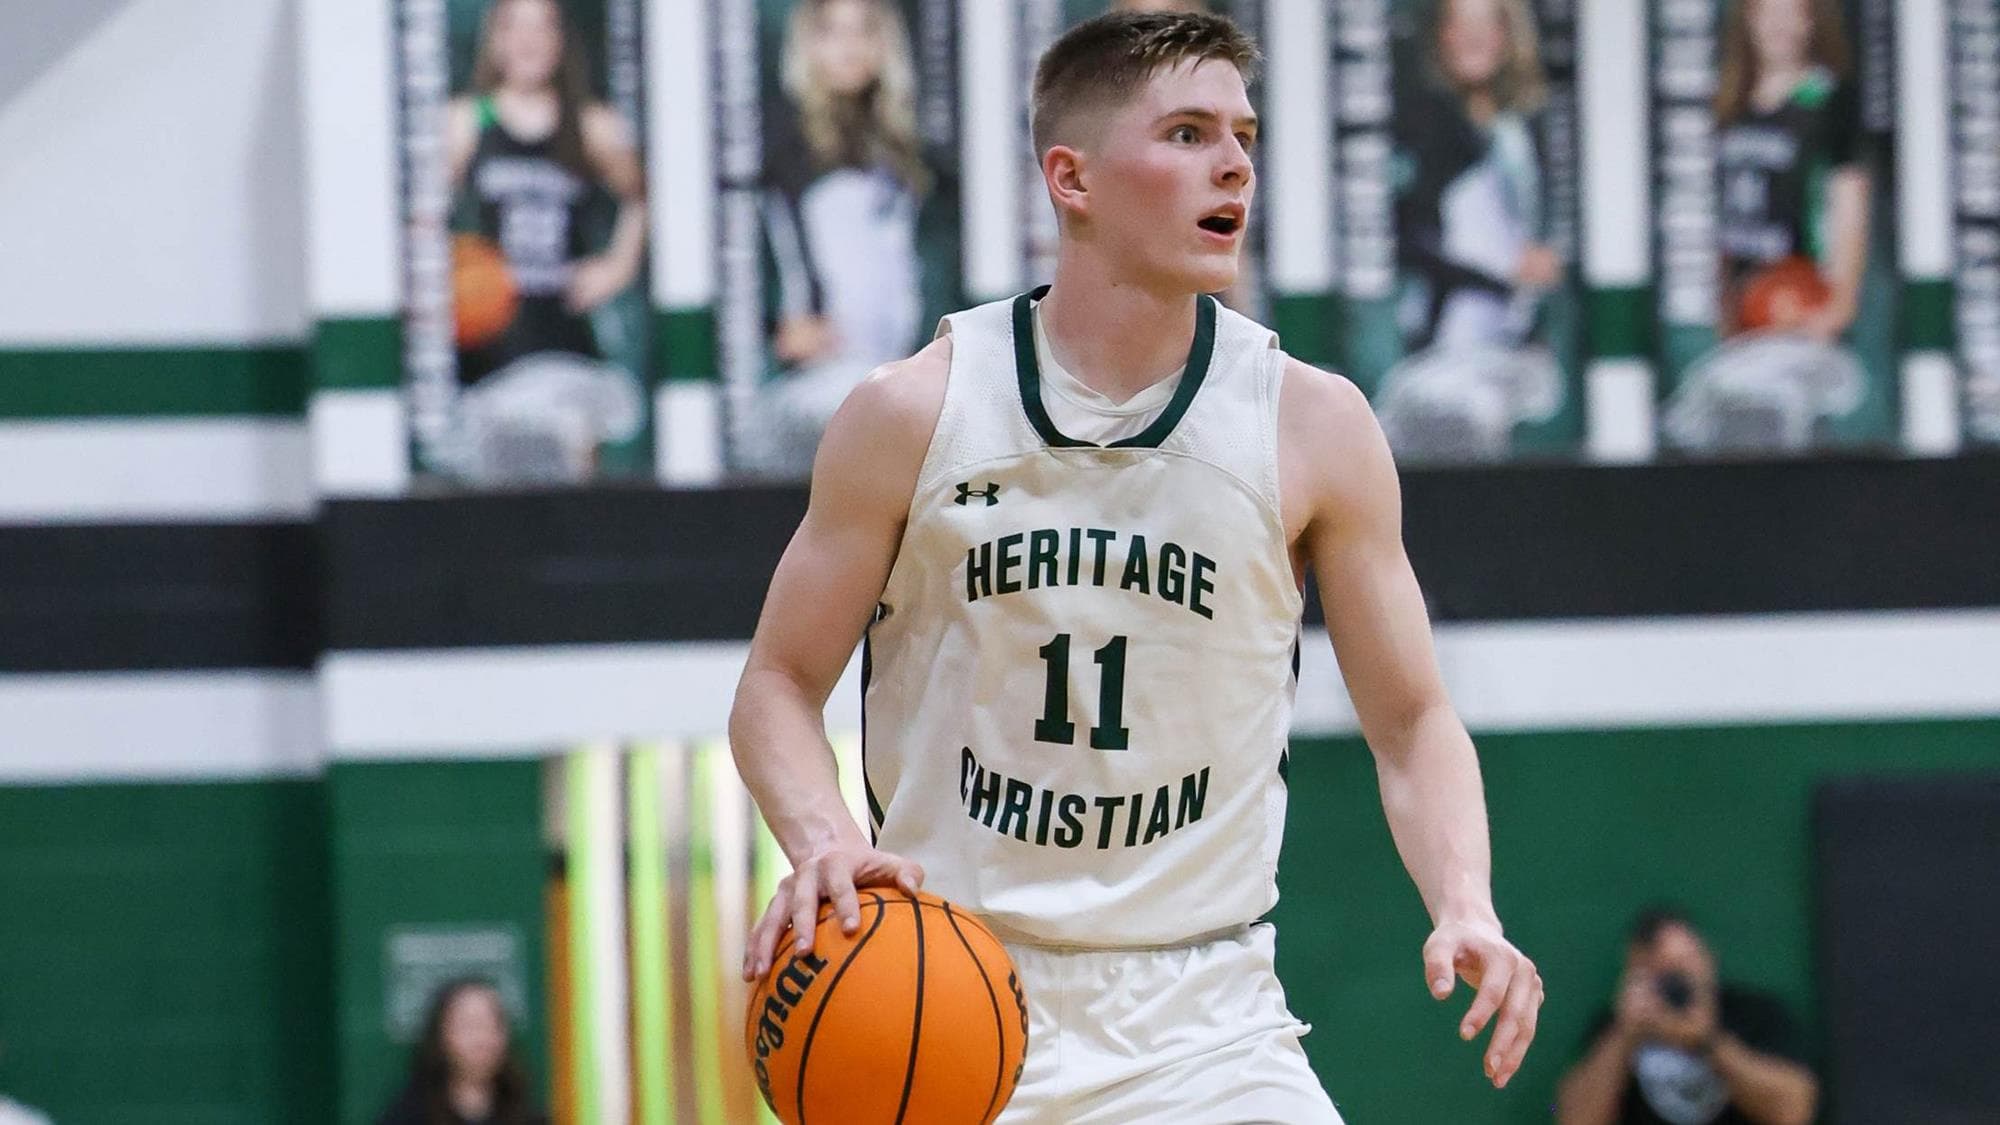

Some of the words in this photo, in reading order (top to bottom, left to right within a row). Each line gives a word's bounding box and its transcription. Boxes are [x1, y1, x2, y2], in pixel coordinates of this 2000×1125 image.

[967, 528, 1216, 620] HERITAGE
[1035, 634, 1129, 750] 11
[961, 746, 1209, 849] CHRISTIAN
